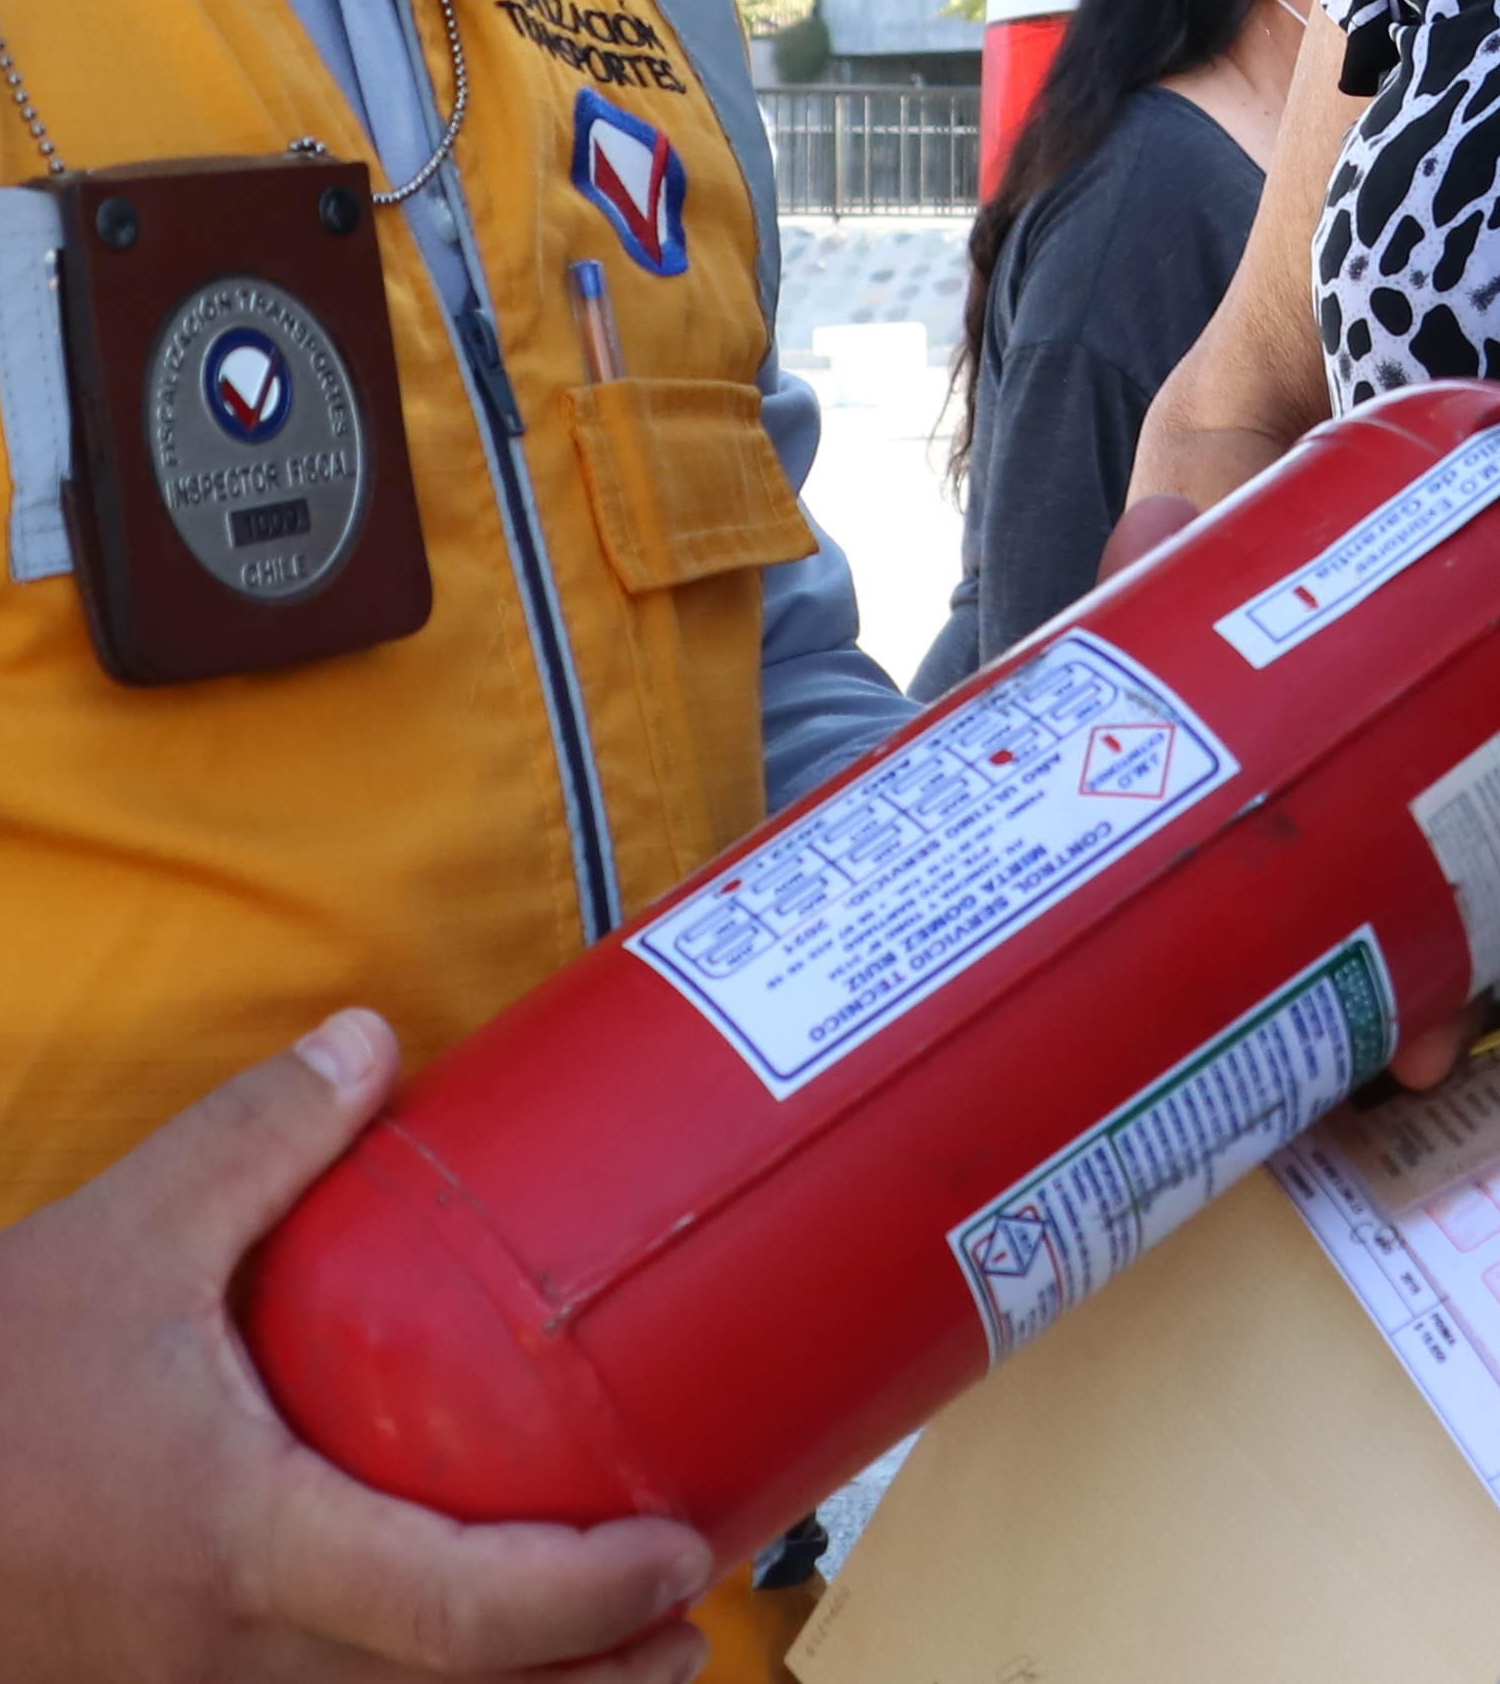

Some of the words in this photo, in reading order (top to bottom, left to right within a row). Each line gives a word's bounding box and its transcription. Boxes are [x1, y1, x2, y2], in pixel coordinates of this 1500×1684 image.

[497, 0, 686, 94] TRANSPORTES
[157, 289, 231, 468] FISCALIZACIÓN
[236, 287, 350, 437] TRANSPORTES
[165, 460, 282, 510] INSPECTOR
[285, 449, 357, 489] FISCAL
[1425, 467, 1458, 499] de
[1351, 494, 1454, 577] Extintores
[241, 555, 307, 589] CHILE
[1019, 750, 1063, 786] AÑO
[942, 782, 1018, 840] ULTIMO
[918, 868, 957, 899] ALTO
[978, 842, 1048, 897] MIRTA
[1011, 819, 1114, 897] CONTROL
[841, 897, 917, 953] SANTIAGO
[898, 892, 979, 954] GOMEZ
[905, 892, 1011, 974] SERVICIO
[926, 899, 939, 911] Y
[780, 916, 829, 956] 2021
[841, 949, 898, 995] RUIZ
[805, 967, 907, 1045] TECNICO
